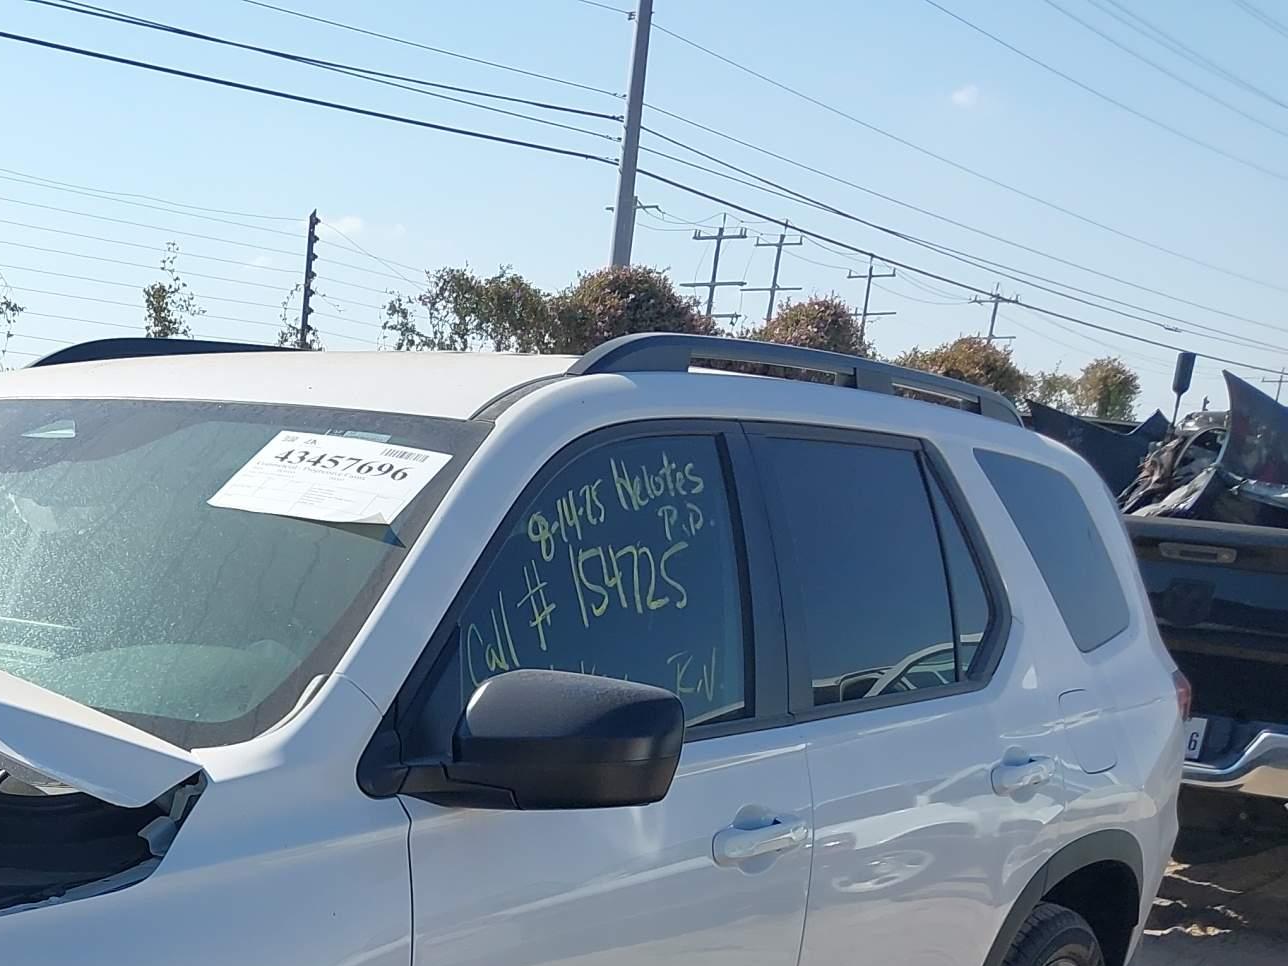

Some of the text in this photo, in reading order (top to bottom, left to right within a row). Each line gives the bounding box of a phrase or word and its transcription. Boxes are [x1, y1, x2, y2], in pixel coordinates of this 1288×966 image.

[275, 448, 415, 482] 43457696
[609, 450, 705, 511] Helotes
[467, 541, 689, 687] Call # 154725
